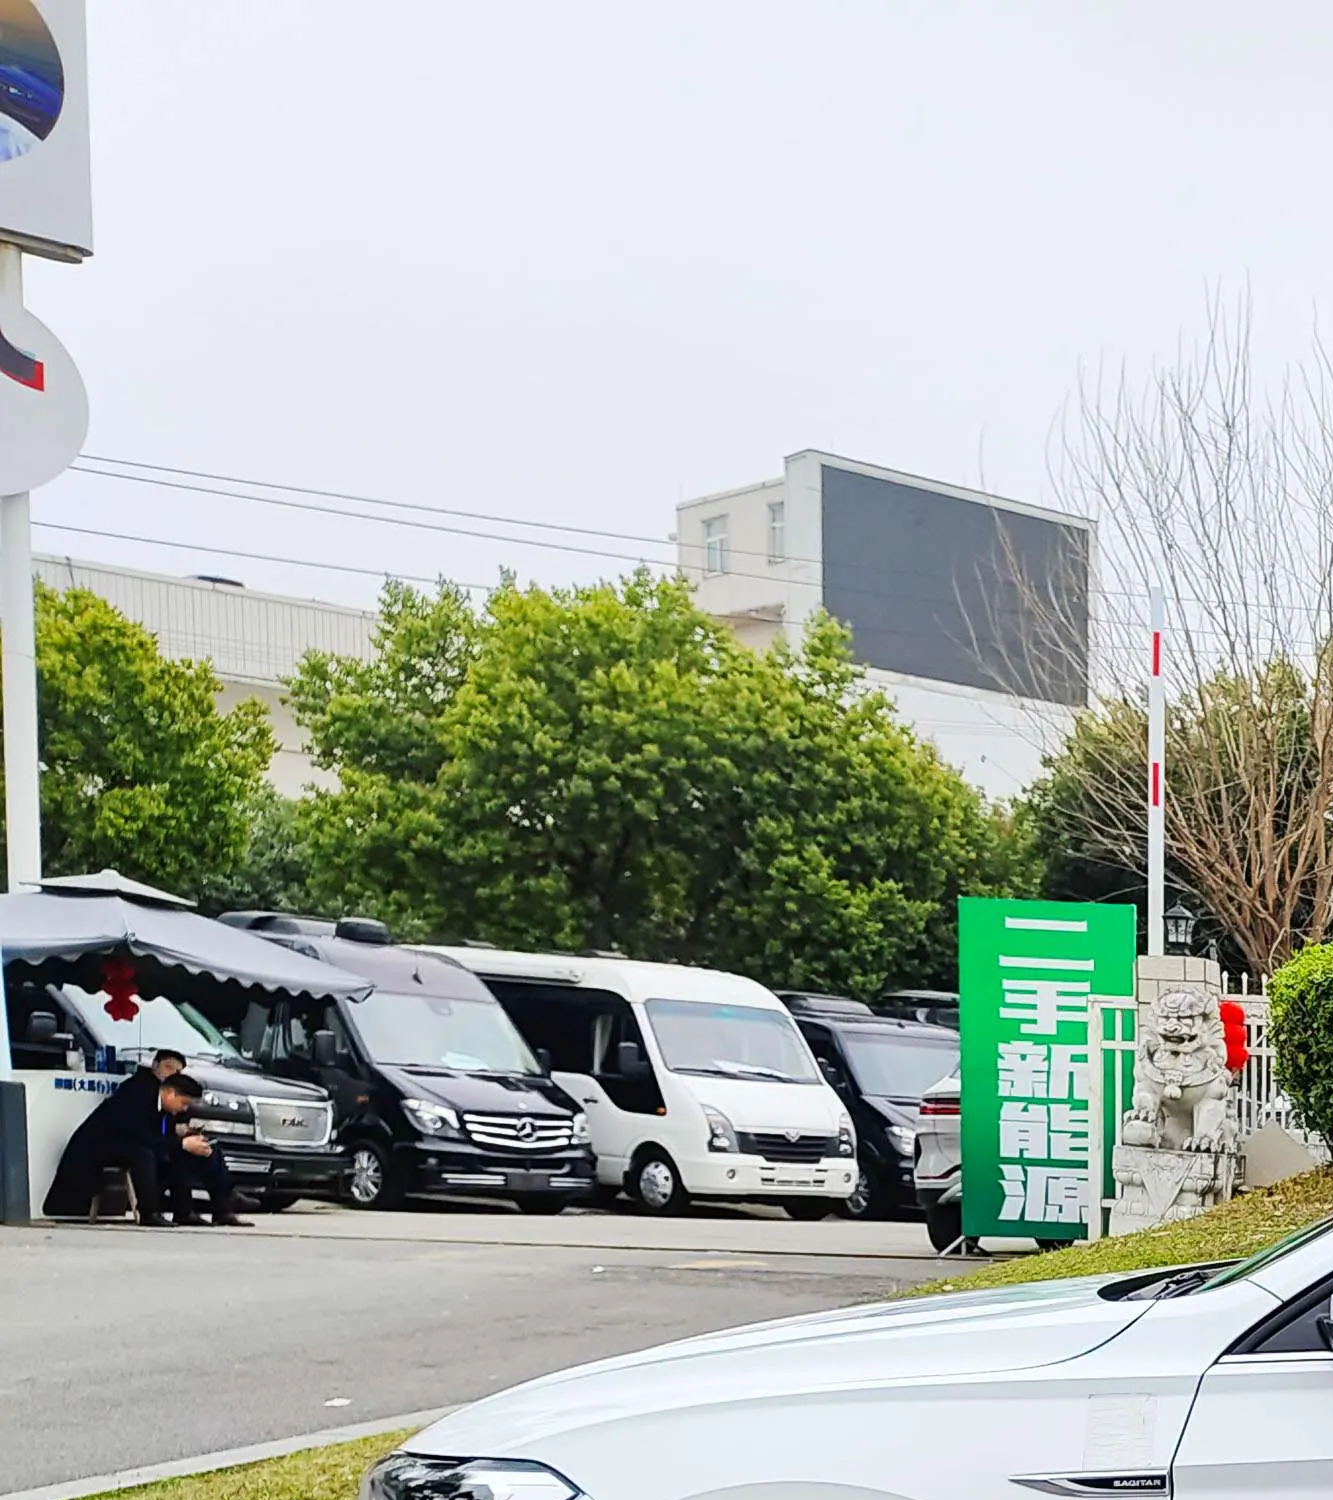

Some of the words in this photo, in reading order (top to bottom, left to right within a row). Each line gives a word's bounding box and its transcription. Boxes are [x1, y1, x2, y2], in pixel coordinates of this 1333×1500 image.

[998, 916, 1095, 1224] 二手新能源
[1112, 1478, 1162, 1488] SAGITAR
